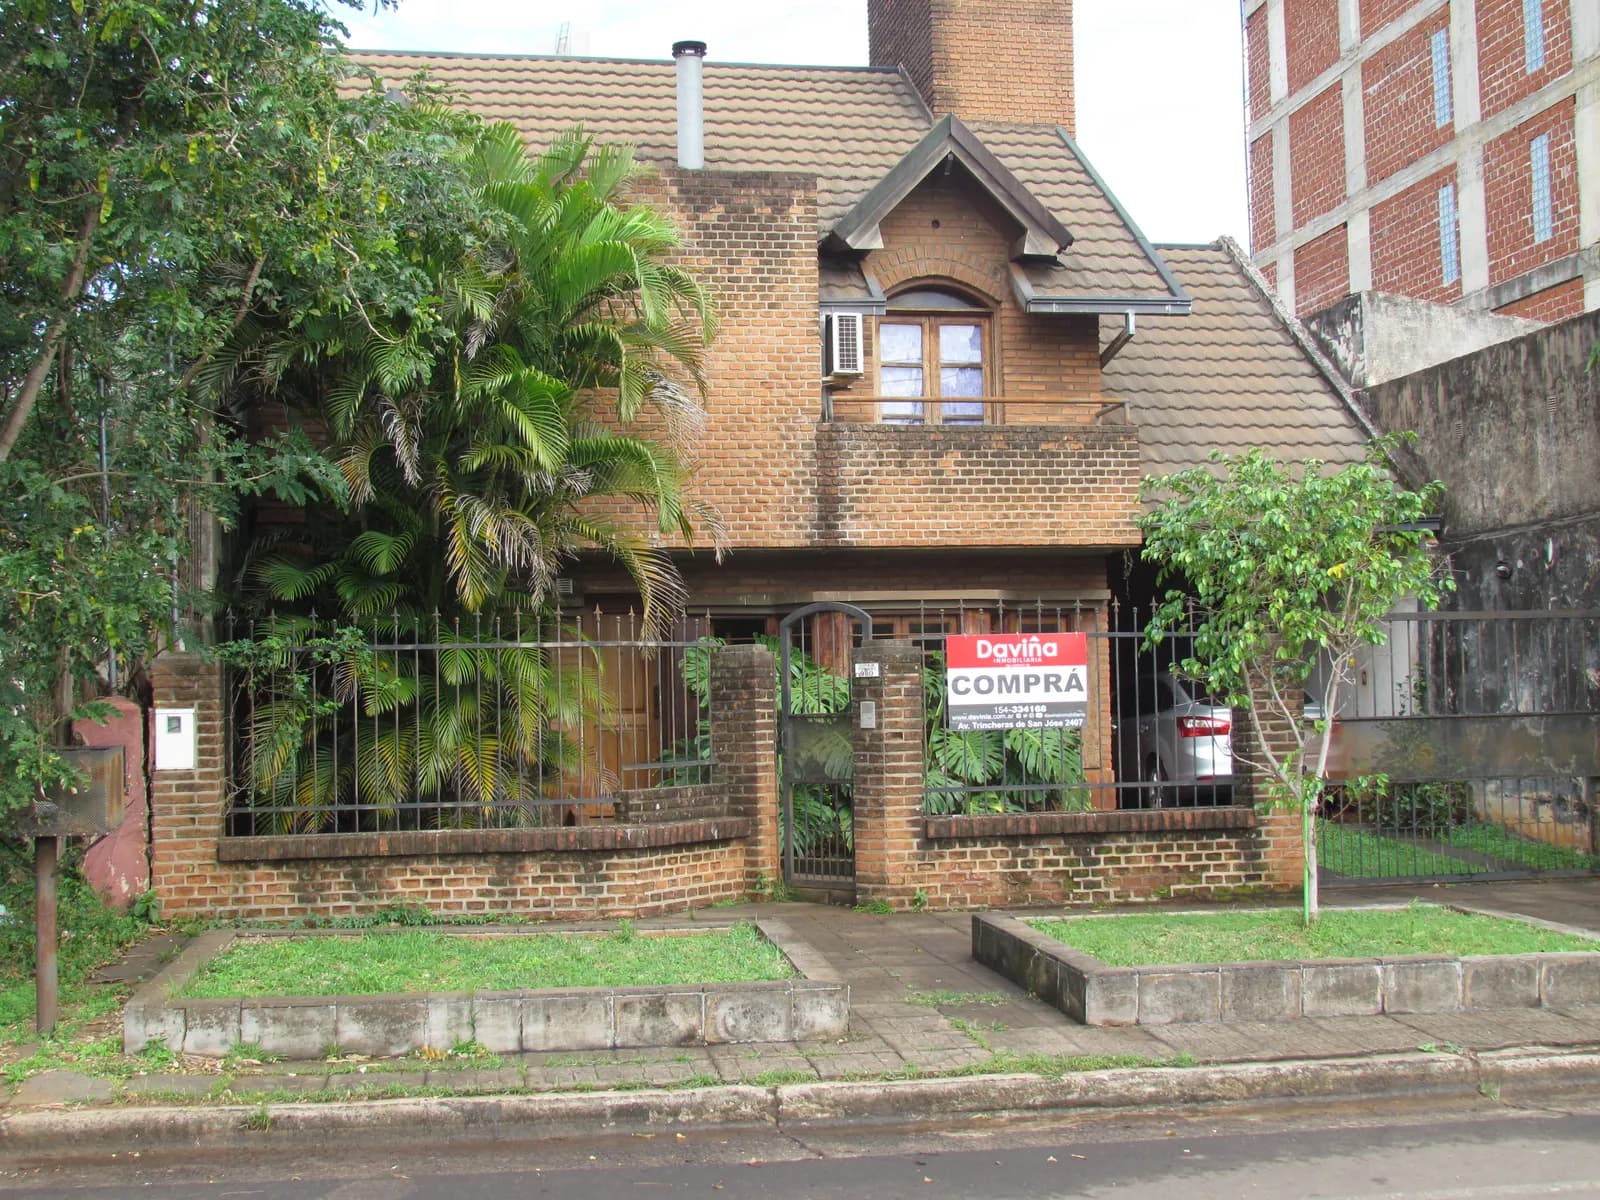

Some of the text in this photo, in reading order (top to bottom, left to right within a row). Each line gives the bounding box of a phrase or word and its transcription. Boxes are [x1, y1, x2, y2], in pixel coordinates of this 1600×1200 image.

[951, 668, 1084, 696] COMPRÁ
[957, 722, 970, 730] Av.
[972, 721, 1014, 729] Trincheras
[1015, 720, 1026, 728] de
[1027, 719, 1043, 728] San
